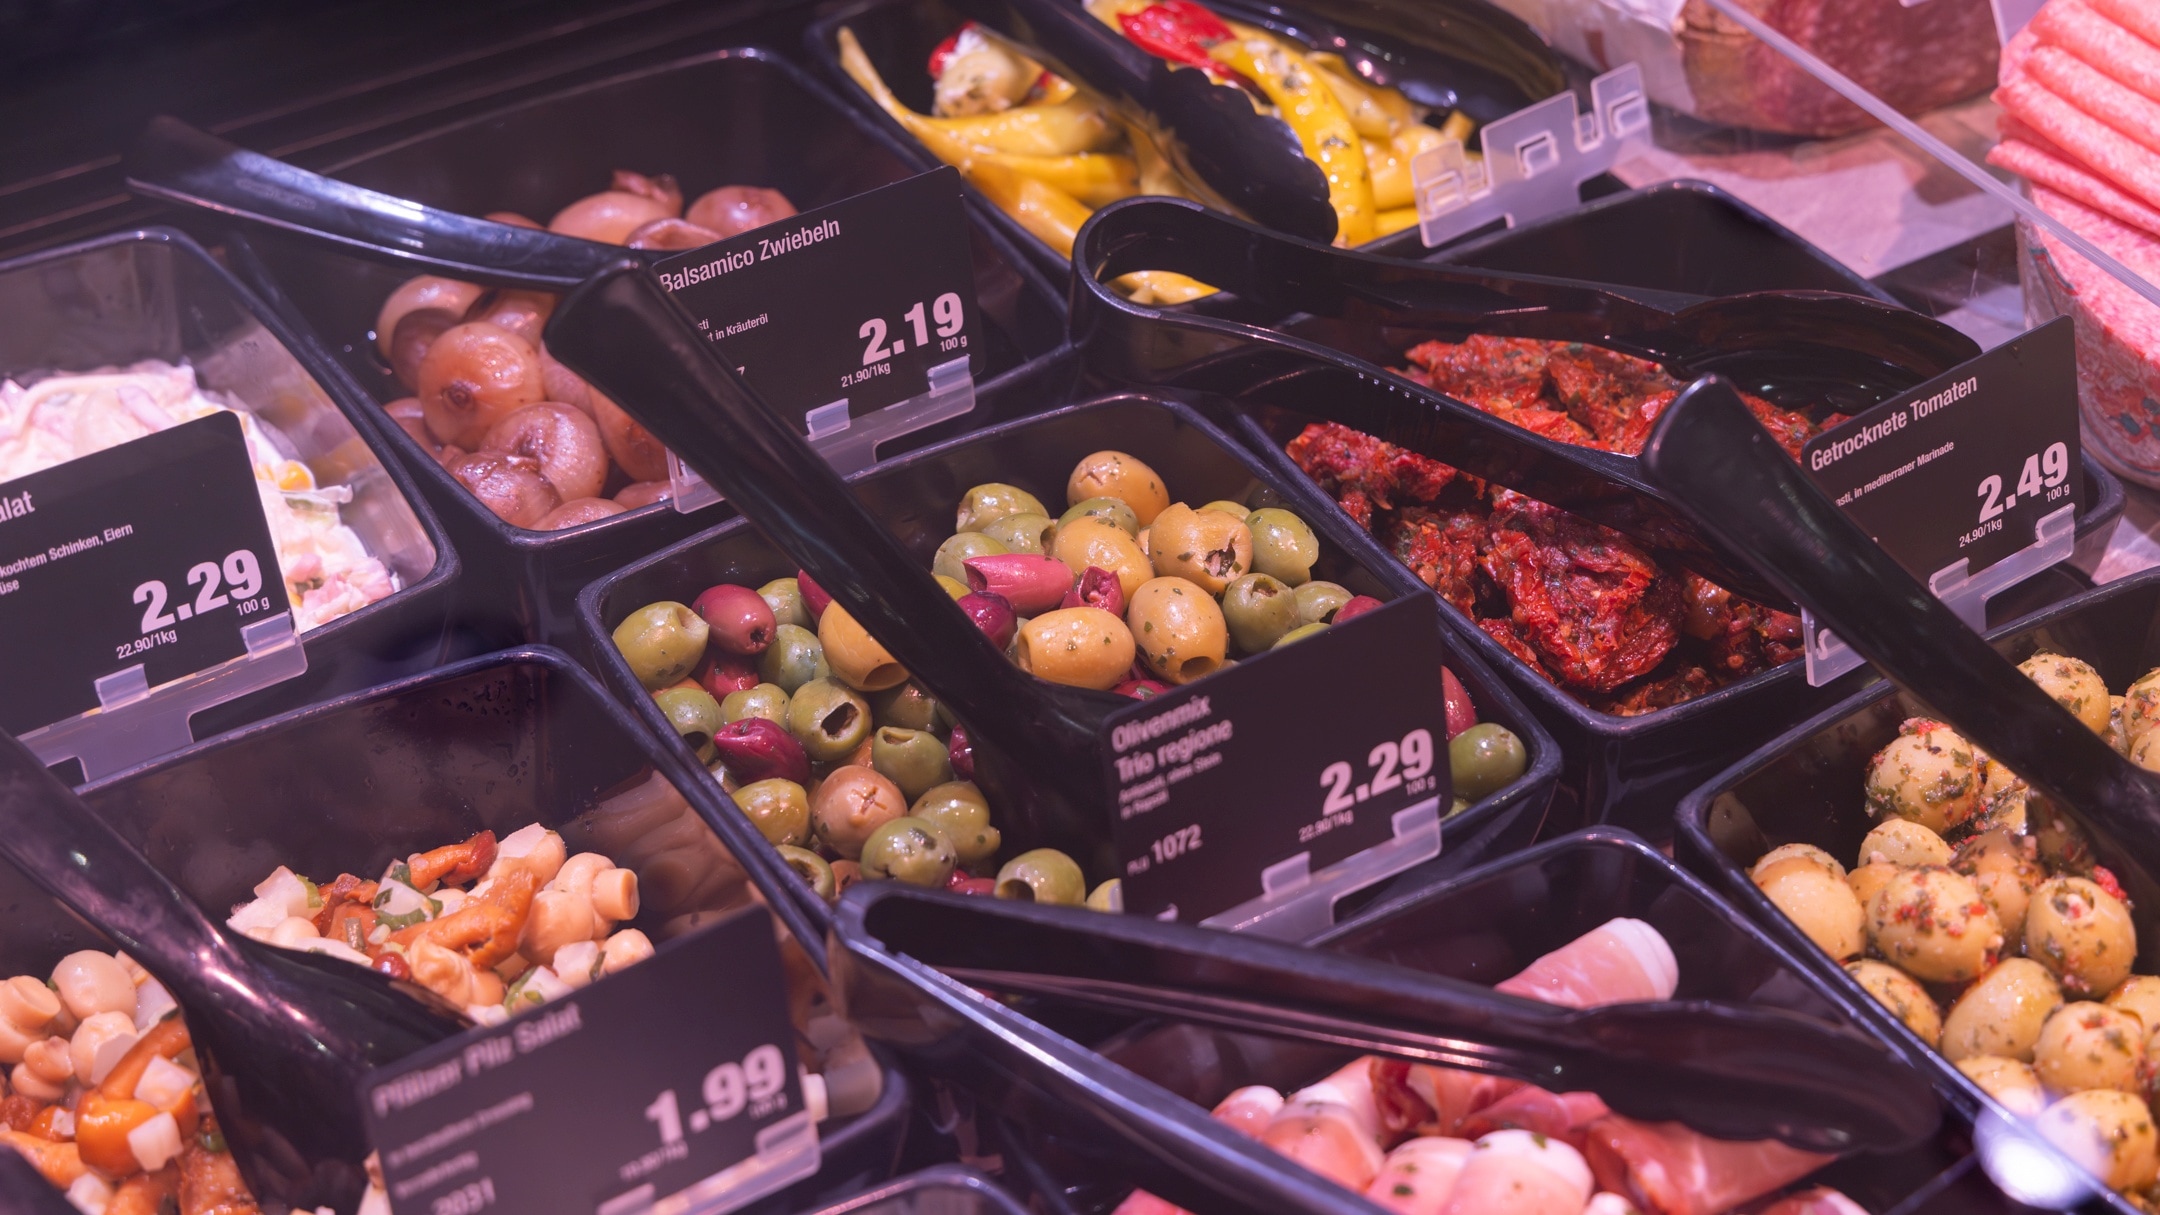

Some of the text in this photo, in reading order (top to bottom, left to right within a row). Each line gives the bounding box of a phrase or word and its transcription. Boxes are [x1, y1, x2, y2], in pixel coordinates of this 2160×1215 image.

[659, 218, 841, 293] Balsamico Zwiebeln
[715, 330, 725, 340] in
[726, 313, 769, 337] Kräuteröl
[859, 292, 964, 366] 2.19
[940, 335, 968, 352] 100 g
[841, 363, 891, 388] 21.90/1kg
[1811, 377, 1977, 472] Getrocknete Tomaten
[1854, 488, 1863, 499] in
[1864, 460, 1916, 493] mediterraner
[1917, 441, 1955, 467] Marinade
[1977, 441, 2069, 524] 2.49
[2046, 484, 2070, 503] 100 g
[49, 535, 103, 561] Schinken,
[1959, 518, 2003, 548] 24.90/1kg
[133, 549, 263, 634] 2.29
[236, 597, 270, 617] 100 g
[116, 629, 178, 660] 22.90/1kg
[1112, 695, 1212, 752] Olivenmix
[1115, 719, 1233, 782] Trio regione
[1320, 729, 1434, 816] 2.29
[1405, 778, 1426, 796] 100
[1151, 824, 1203, 864] 1072
[645, 1044, 787, 1146] 1.99
